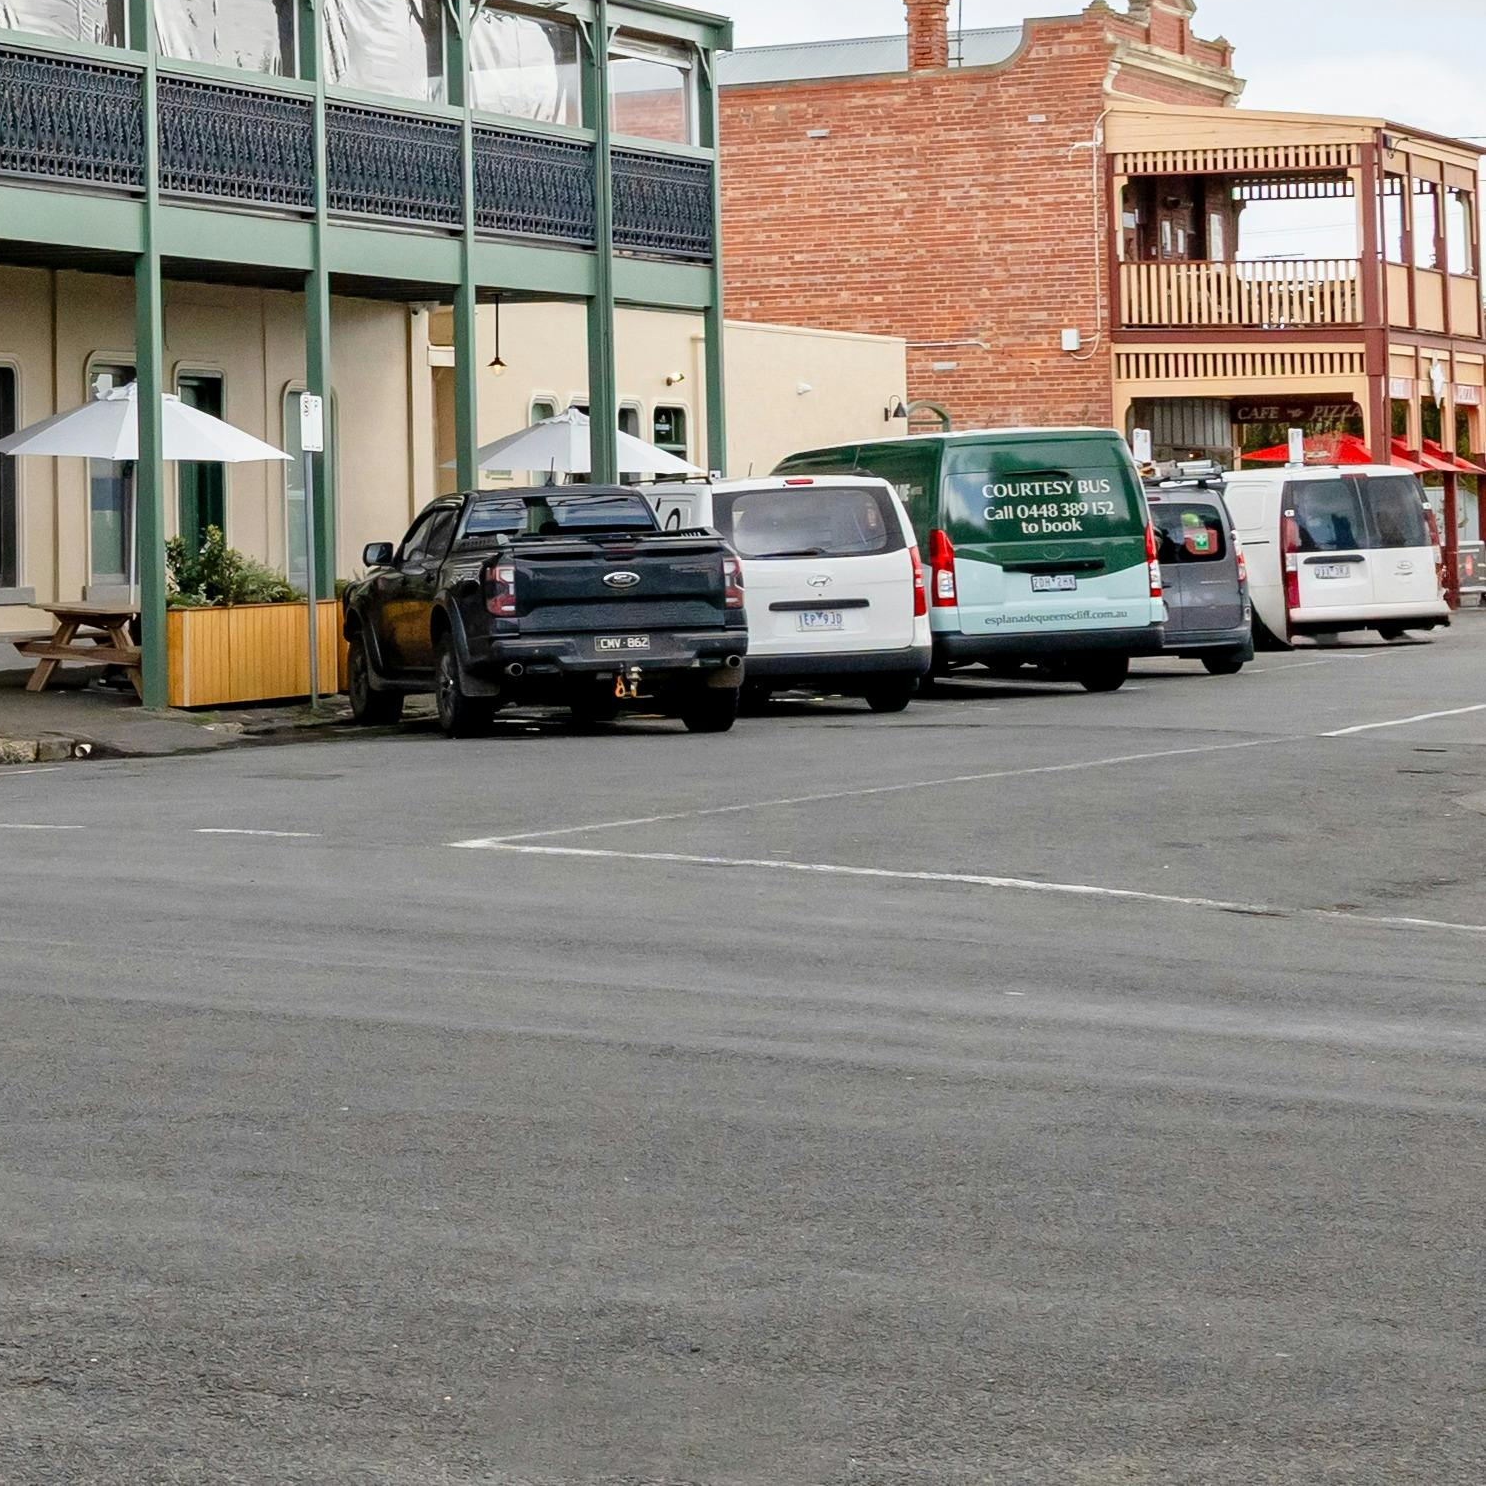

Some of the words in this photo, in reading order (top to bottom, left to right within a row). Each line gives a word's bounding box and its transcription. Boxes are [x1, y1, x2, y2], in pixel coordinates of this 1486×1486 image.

[981, 480, 1073, 499] COURTESY
[1078, 478, 1111, 494] BUS
[983, 505, 1013, 521] Call
[1016, 503, 1059, 519] 0448
[1060, 501, 1088, 517] 389
[1091, 500, 1116, 516] 152
[1021, 521, 1039, 534] to
[1042, 518, 1084, 533] book
[984, 610, 1128, 626] esplanadequeenscliff.com.au
